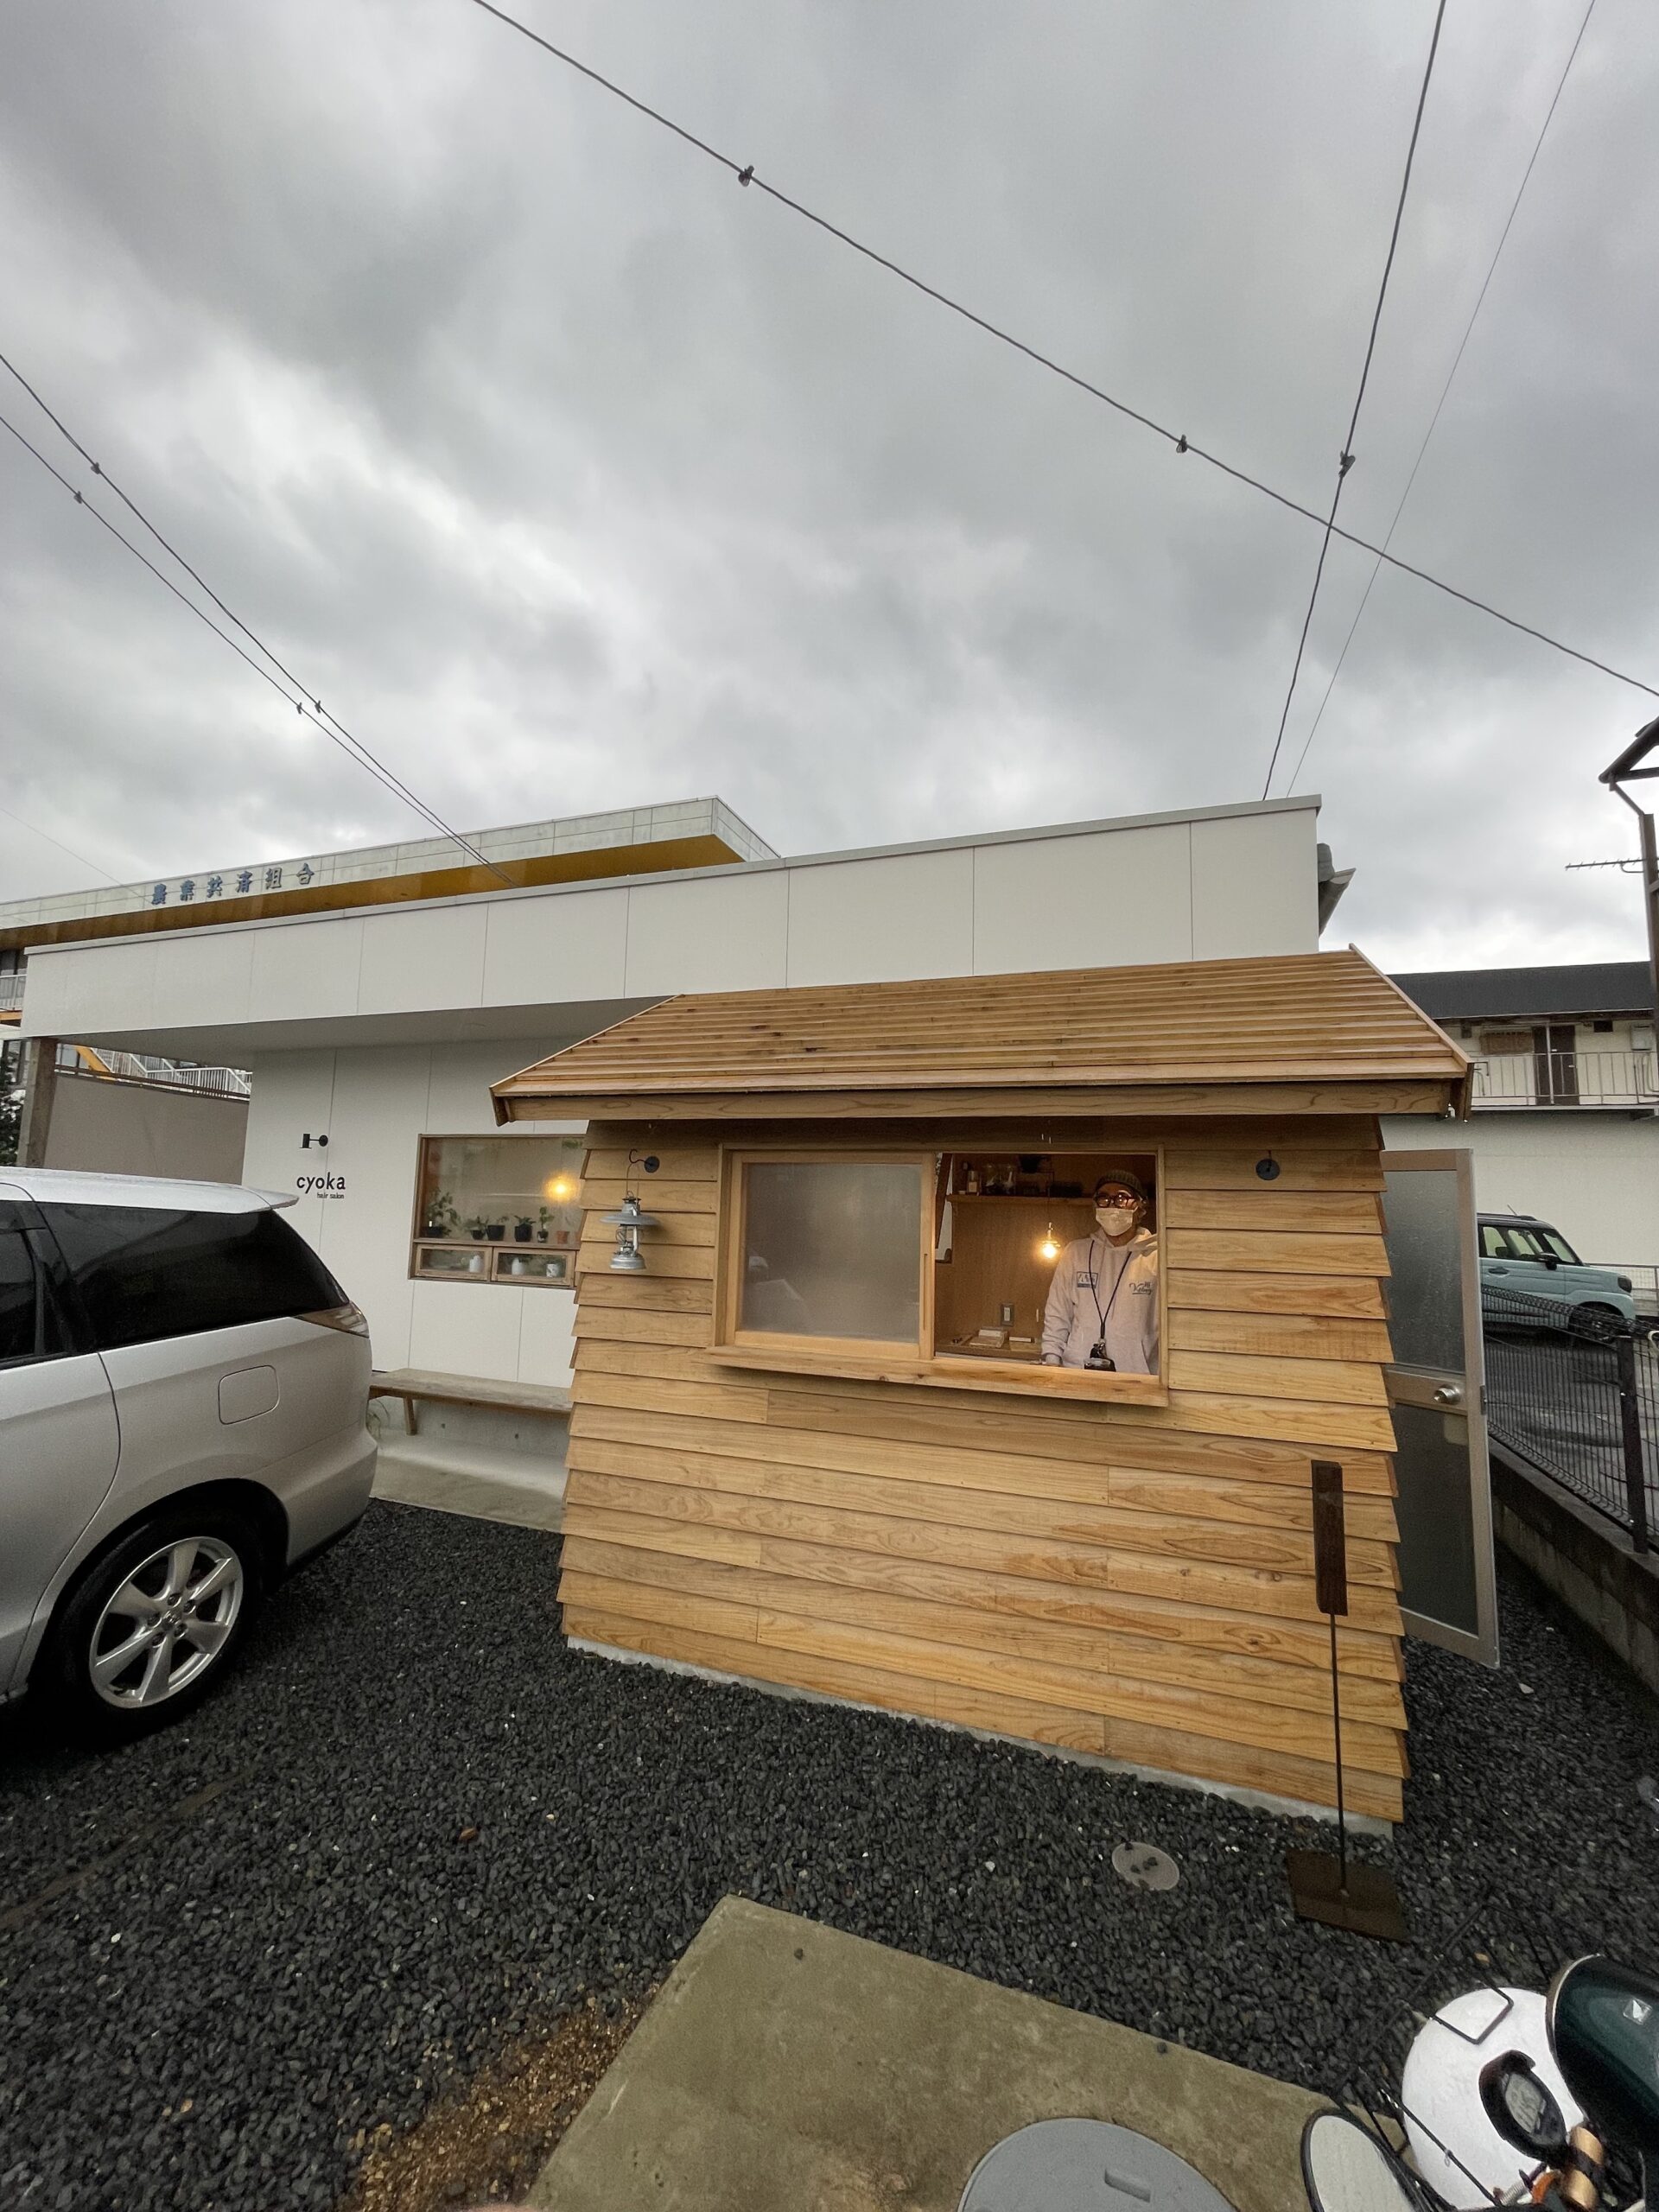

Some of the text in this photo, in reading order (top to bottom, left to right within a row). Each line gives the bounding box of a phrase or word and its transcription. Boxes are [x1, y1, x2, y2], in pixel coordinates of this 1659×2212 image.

[151, 862, 315, 905] 農業共済組合
[296, 1172, 346, 1194] cyoka
